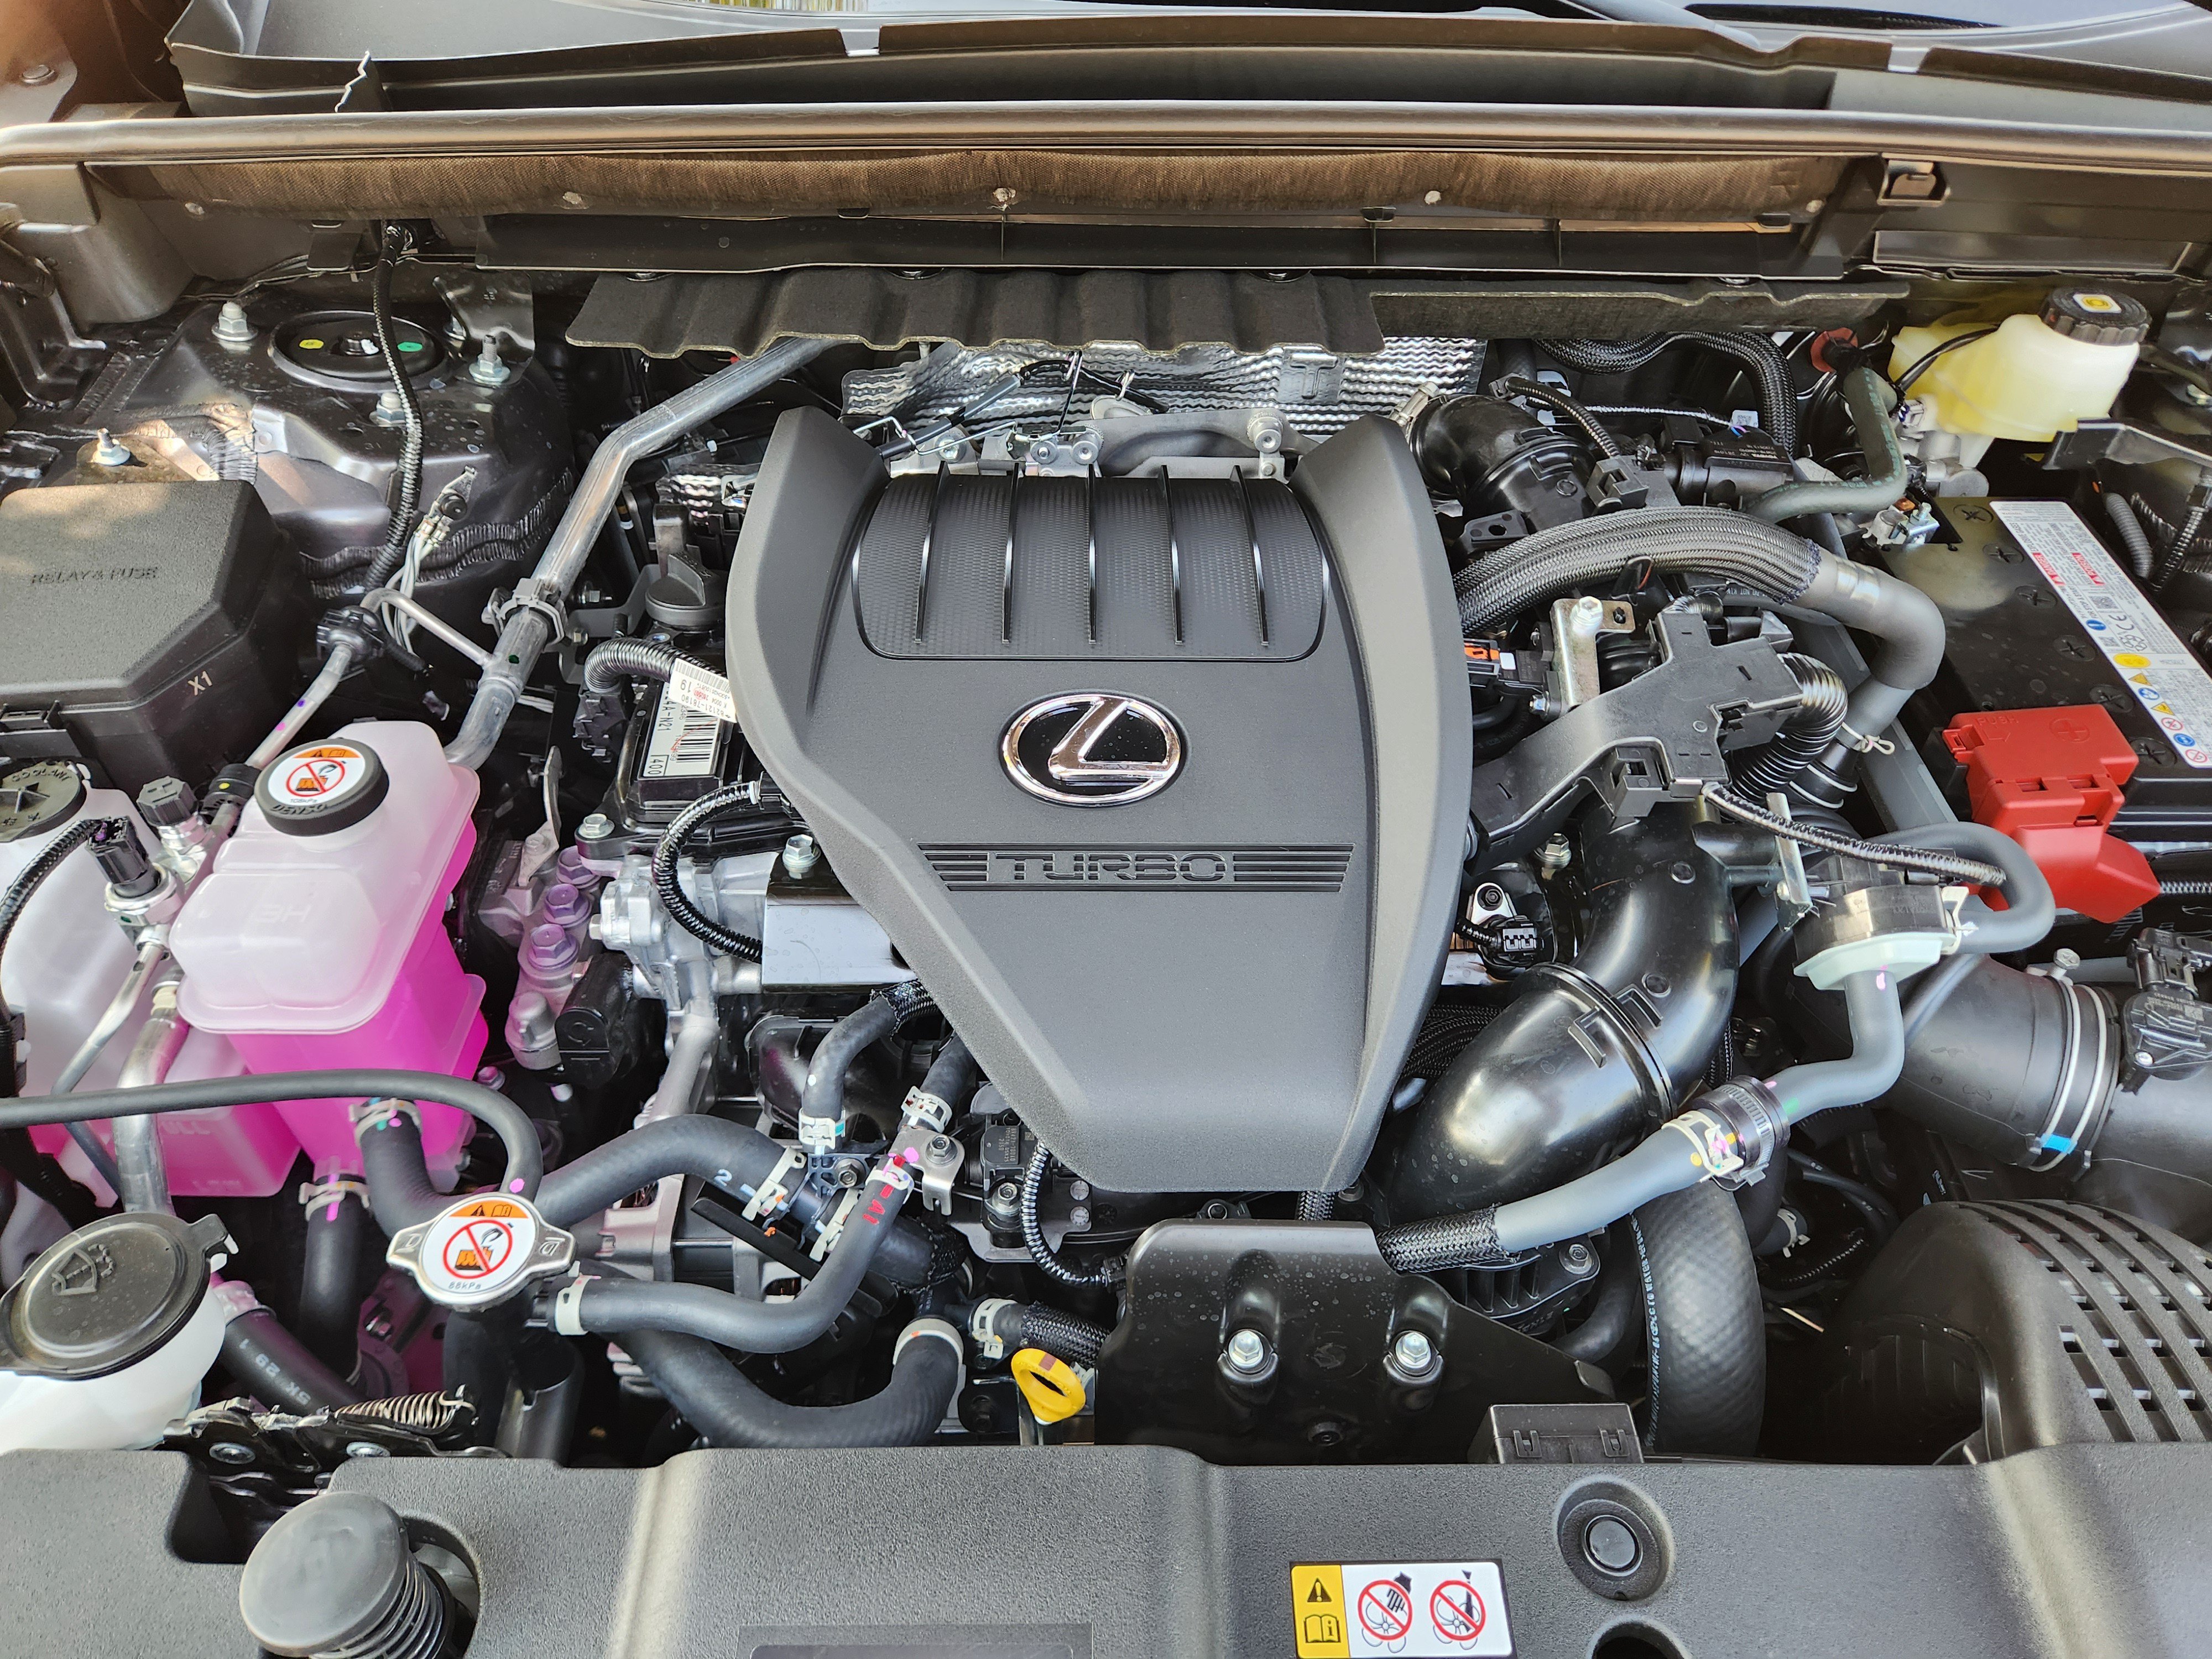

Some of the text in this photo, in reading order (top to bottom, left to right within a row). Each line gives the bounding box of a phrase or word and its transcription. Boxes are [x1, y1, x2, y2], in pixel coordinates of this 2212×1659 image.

[187, 670, 212, 696] X1
[680, 679, 692, 693] 19
[647, 758, 666, 775] 400
[270, 803, 327, 816] DENSO
[995, 852, 1227, 881] TURBO
[713, 1169, 733, 1187] 2
